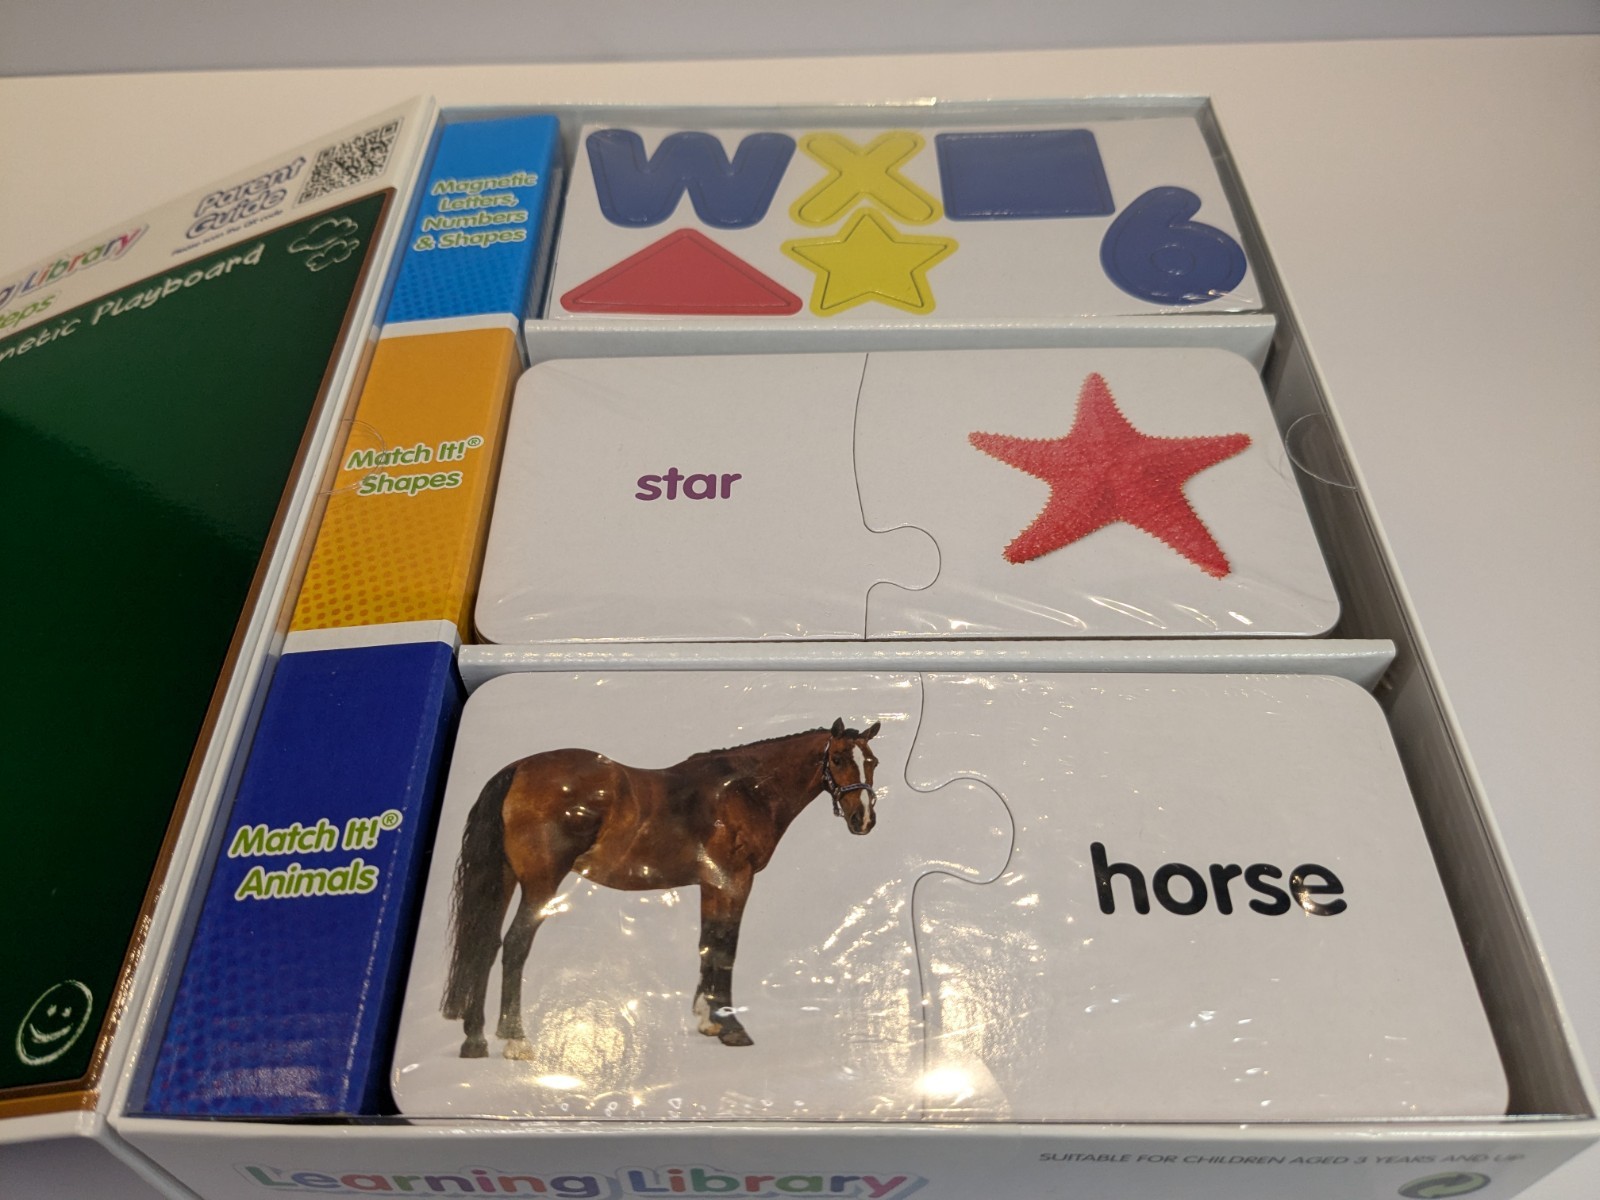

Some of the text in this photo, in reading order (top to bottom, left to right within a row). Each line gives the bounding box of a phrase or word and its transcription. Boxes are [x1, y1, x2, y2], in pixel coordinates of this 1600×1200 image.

[193, 156, 307, 218] Parent
[432, 172, 538, 195] Magnetic
[186, 188, 287, 239] Guide
[439, 193, 519, 212] Letters,
[422, 210, 528, 232] Numbers
[413, 228, 527, 251] & Shapes
[21, 226, 143, 295] Library
[91, 243, 266, 326] Playboard
[345, 442, 433, 470] Match
[358, 471, 463, 496] Shapes
[635, 467, 742, 501] star
[228, 817, 339, 858] Match
[235, 857, 379, 901] Animals
[1090, 841, 1348, 917] horse
[1039, 1152, 1132, 1163] SUITABLE
[1136, 1153, 1178, 1164] FOR
[1182, 1154, 1286, 1165] CHILDREN
[1288, 1155, 1349, 1165] AGED
[1353, 1155, 1368, 1165] 3
[1375, 1155, 1437, 1164] YEARS
[1440, 1153, 1489, 1164] AND
[244, 1165, 909, 1199] Learning Library
